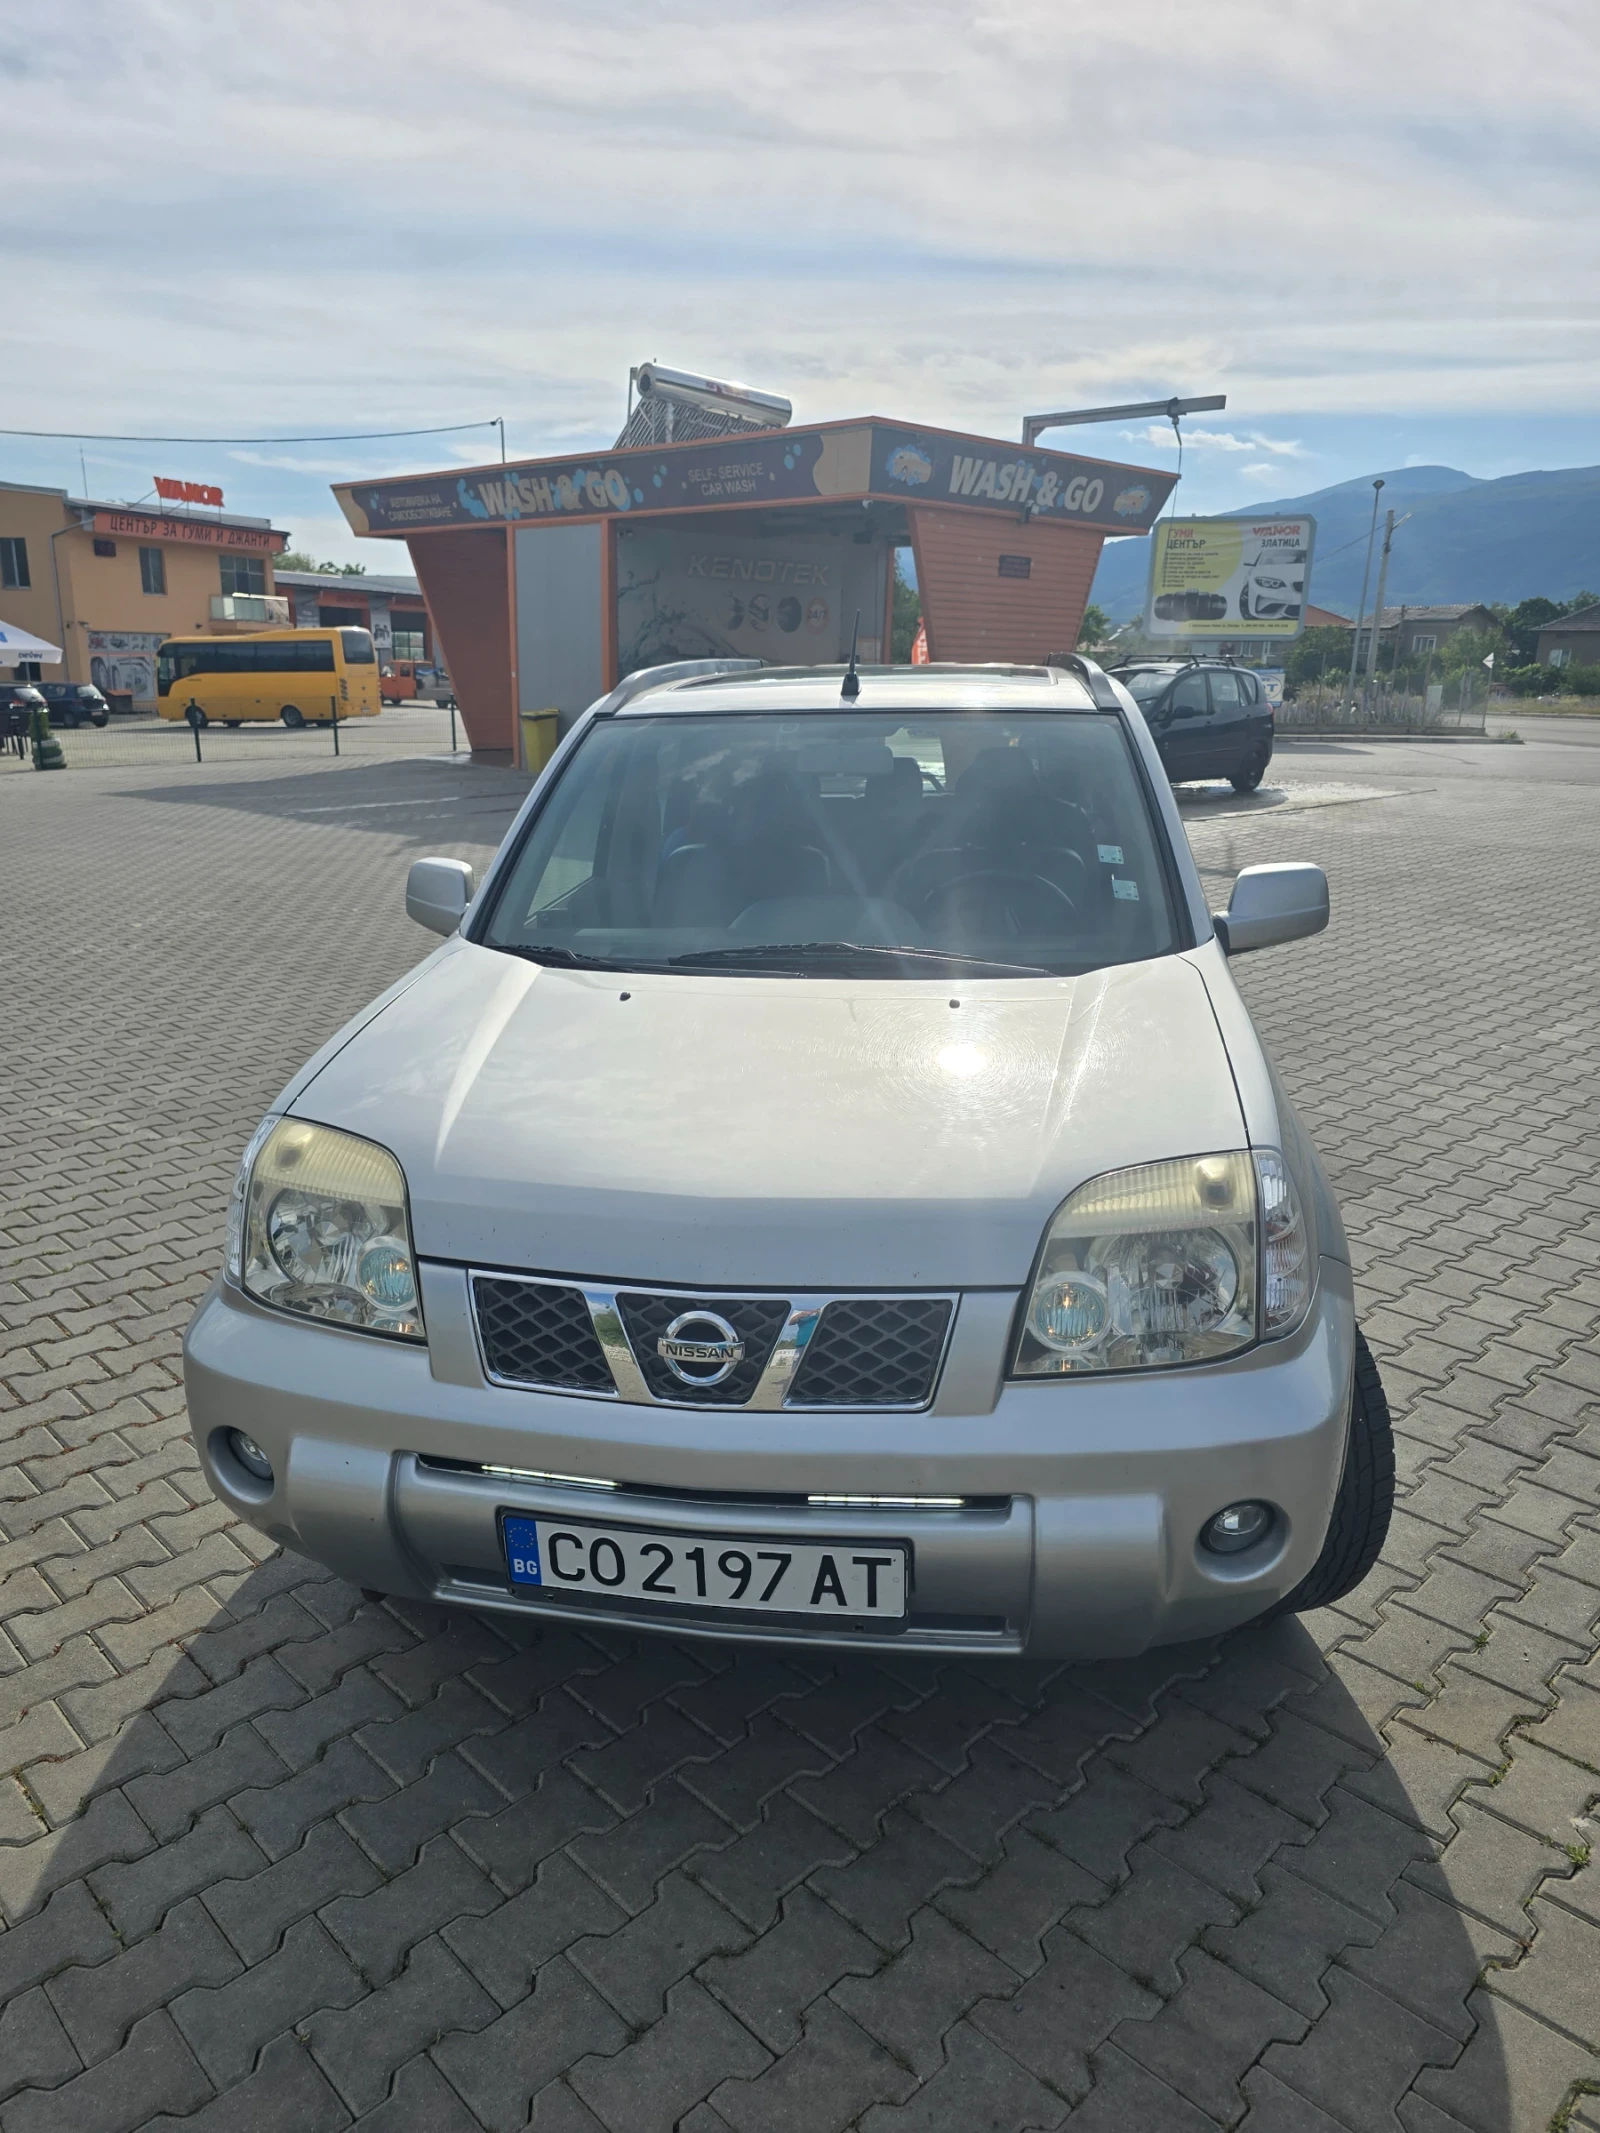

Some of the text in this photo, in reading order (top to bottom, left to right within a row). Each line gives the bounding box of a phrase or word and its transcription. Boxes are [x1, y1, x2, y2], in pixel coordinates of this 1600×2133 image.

[718, 462, 764, 480] SERVICE
[478, 469, 628, 516] WASH & GO
[701, 479, 757, 496] CAR WASH
[949, 455, 1104, 513] WASH & GO
[110, 515, 270, 548] ЦЕНТЪР ЗА ГУМИ И ДЖАНТИ
[1168, 528, 1194, 538] ГУМИ
[1166, 539, 1206, 550] ЦЕНТЪР
[1261, 538, 1300, 549] ЗЛАТИЦА
[688, 554, 829, 586] KENOTEK
[665, 1344, 734, 1359] NISSAN
[513, 1558, 538, 1576] BG
[547, 1532, 893, 1608] CO 2197 AT
